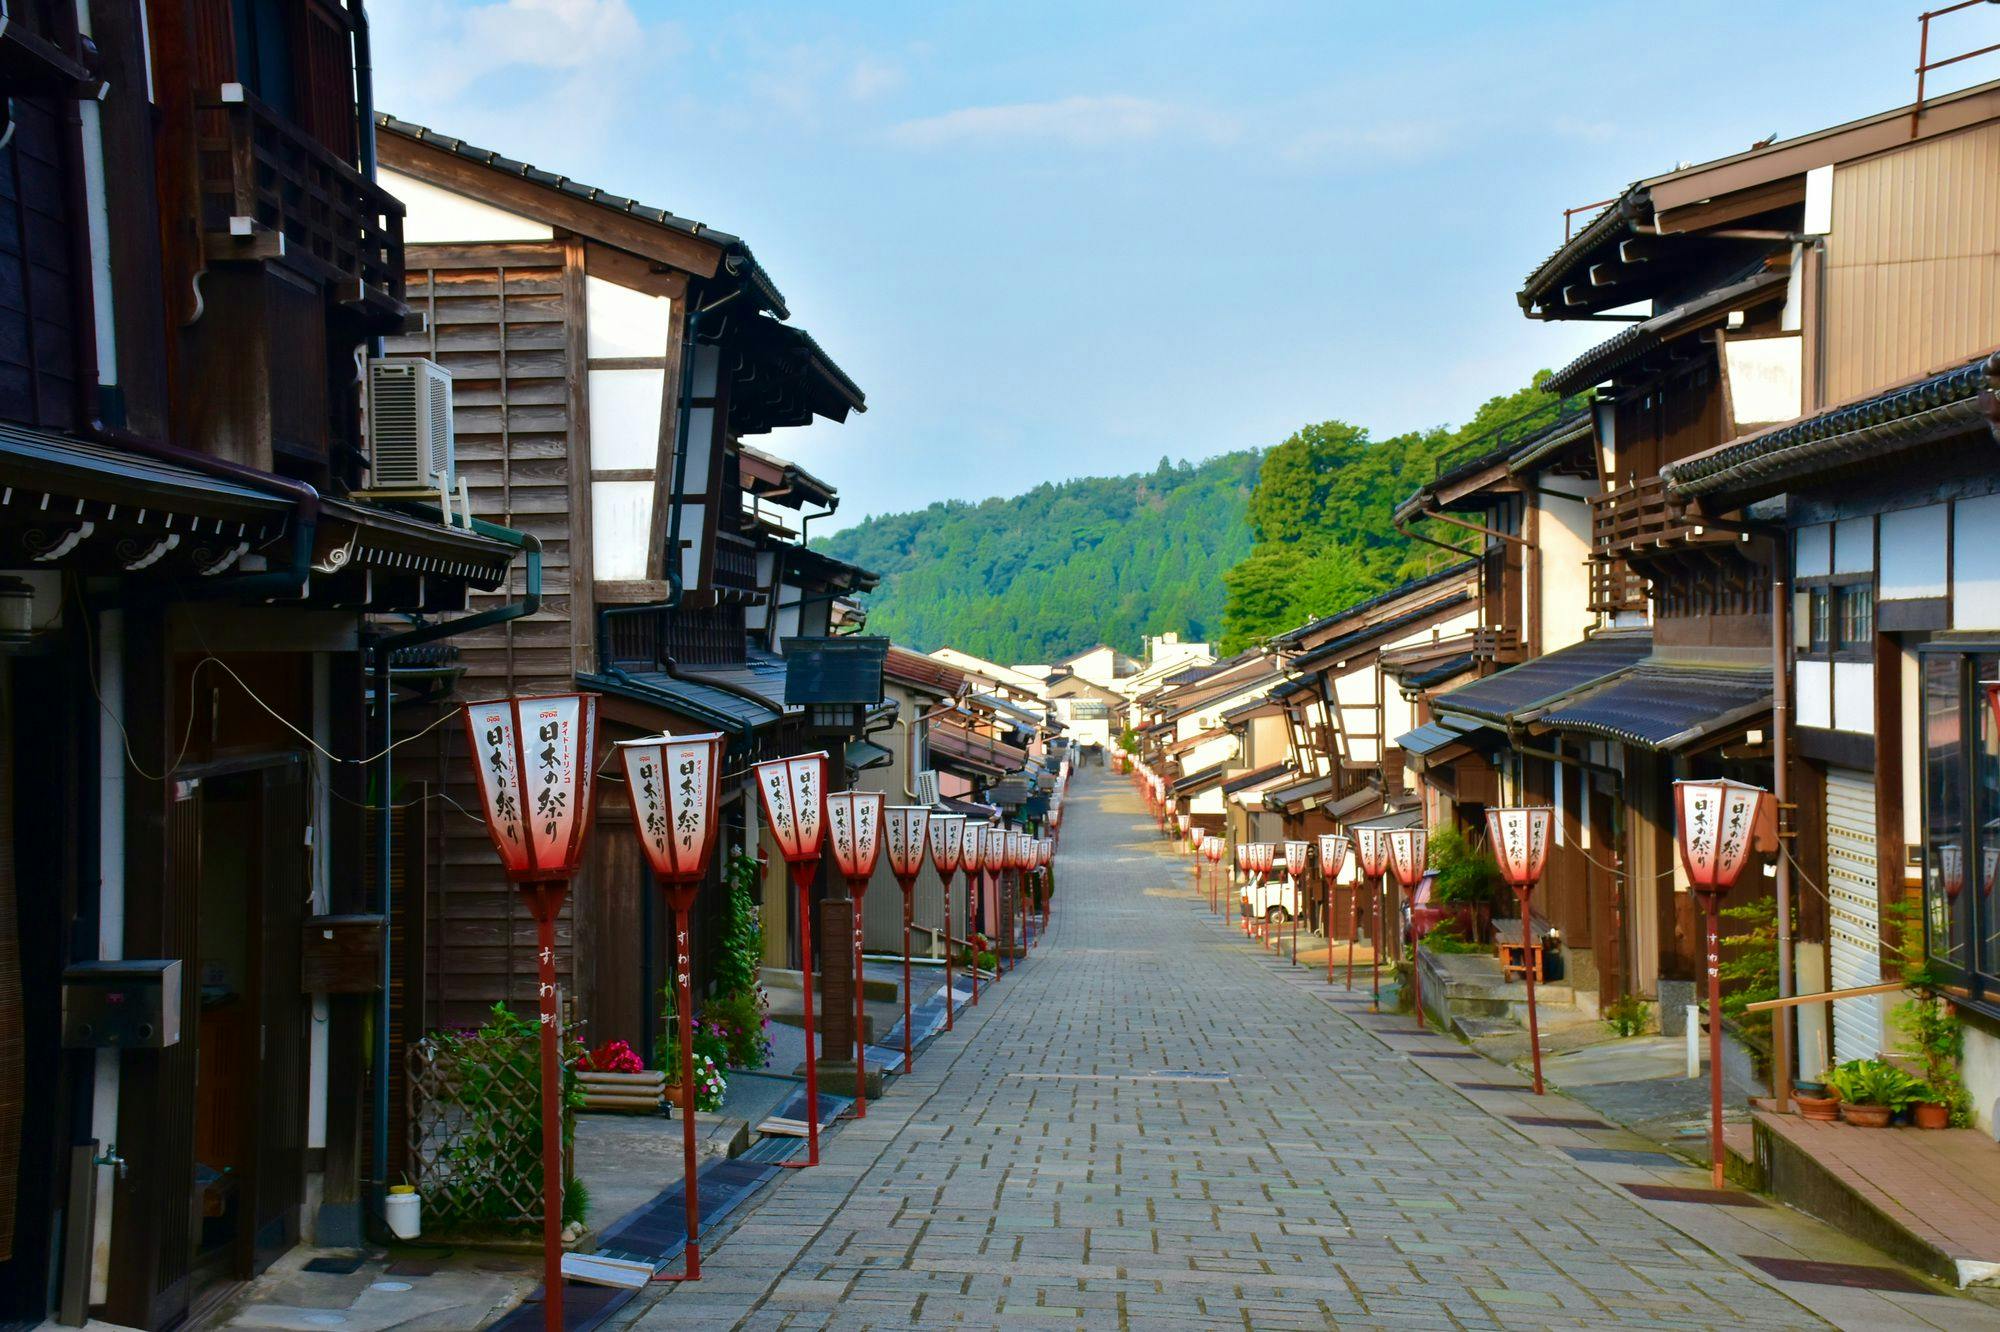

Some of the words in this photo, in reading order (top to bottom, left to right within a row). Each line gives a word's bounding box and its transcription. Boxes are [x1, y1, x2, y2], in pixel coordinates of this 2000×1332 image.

[487, 725, 519, 845] 日本の祭り
[537, 721, 566, 843] 日本の祭り
[562, 720, 571, 784] ダイドードリンコ
[640, 764, 665, 854] 日本の祭り
[677, 760, 699, 852] 日本の祭り
[770, 776, 791, 841] 日本の祭り
[800, 771, 816, 839] 日本の祭り
[835, 806, 850, 861] 日本の祭り
[858, 805, 872, 861] 日本の祭り
[1691, 800, 1710, 868] 日本の祭り
[1721, 803, 1745, 871] 日本の祭り
[1509, 820, 1523, 868] 日本の祭り
[539, 946, 556, 1028] すわ町
[677, 931, 688, 988] すわ町
